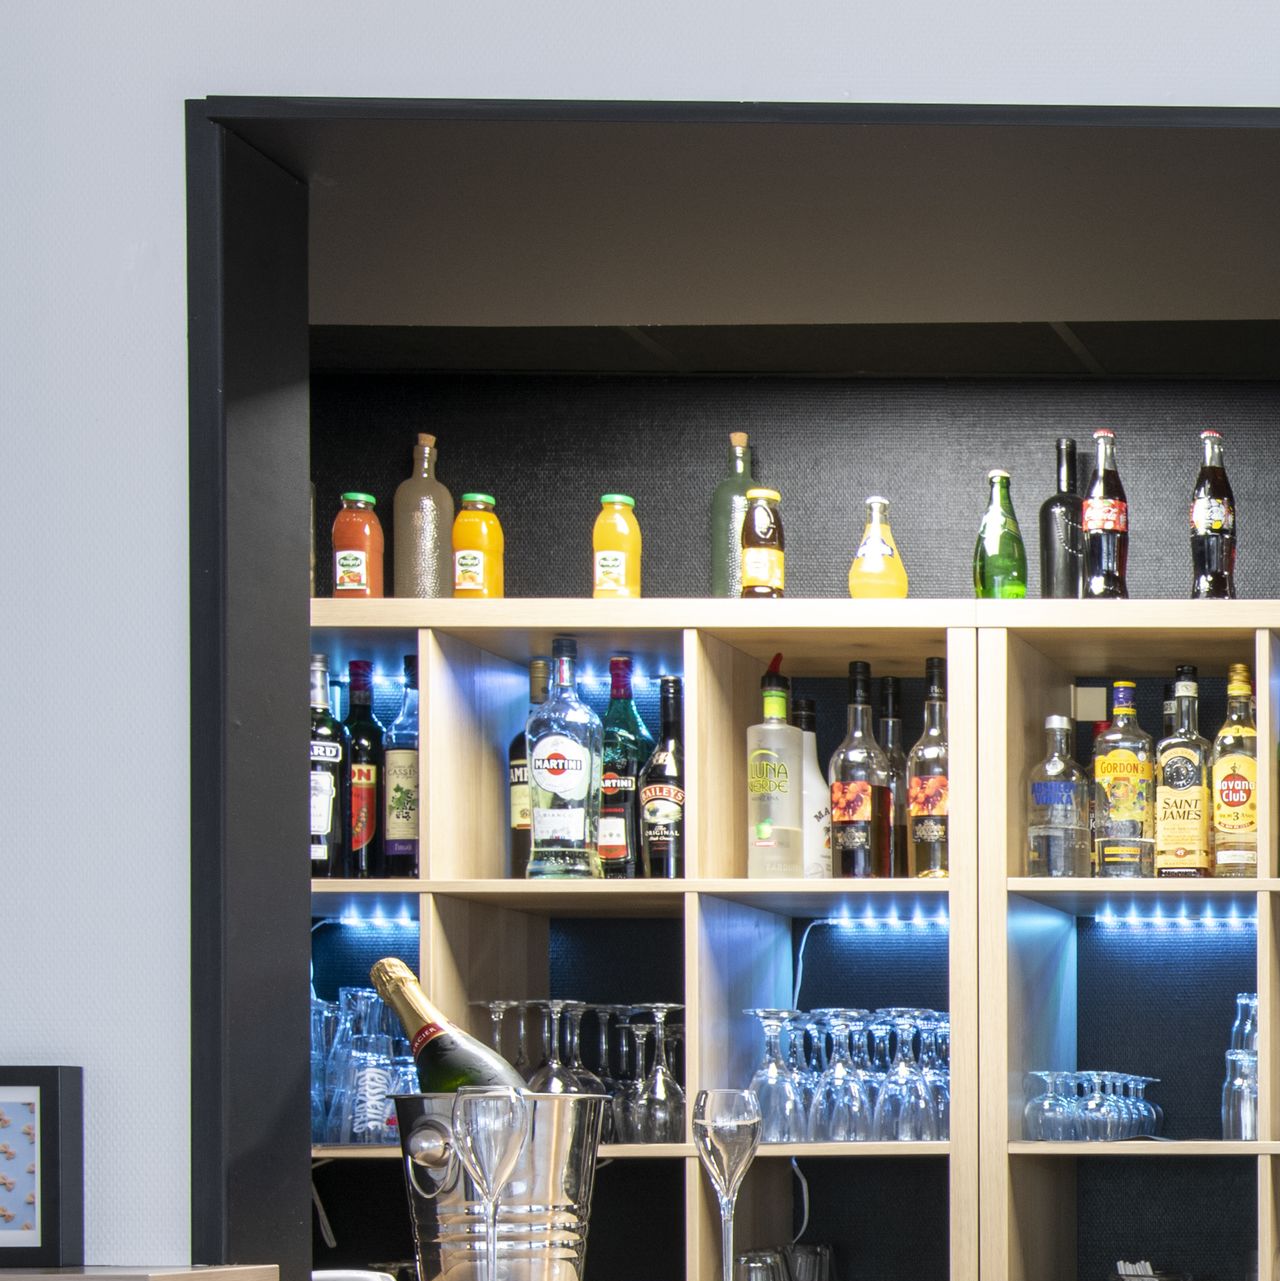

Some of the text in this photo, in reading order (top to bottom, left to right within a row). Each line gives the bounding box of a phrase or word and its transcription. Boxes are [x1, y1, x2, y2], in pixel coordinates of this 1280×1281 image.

[535, 759, 582, 770] MARTINI
[751, 762, 789, 780] LUNA
[1222, 790, 1247, 802] Club
[1162, 798, 1201, 810] SAINT
[1160, 809, 1202, 821] JAMES
